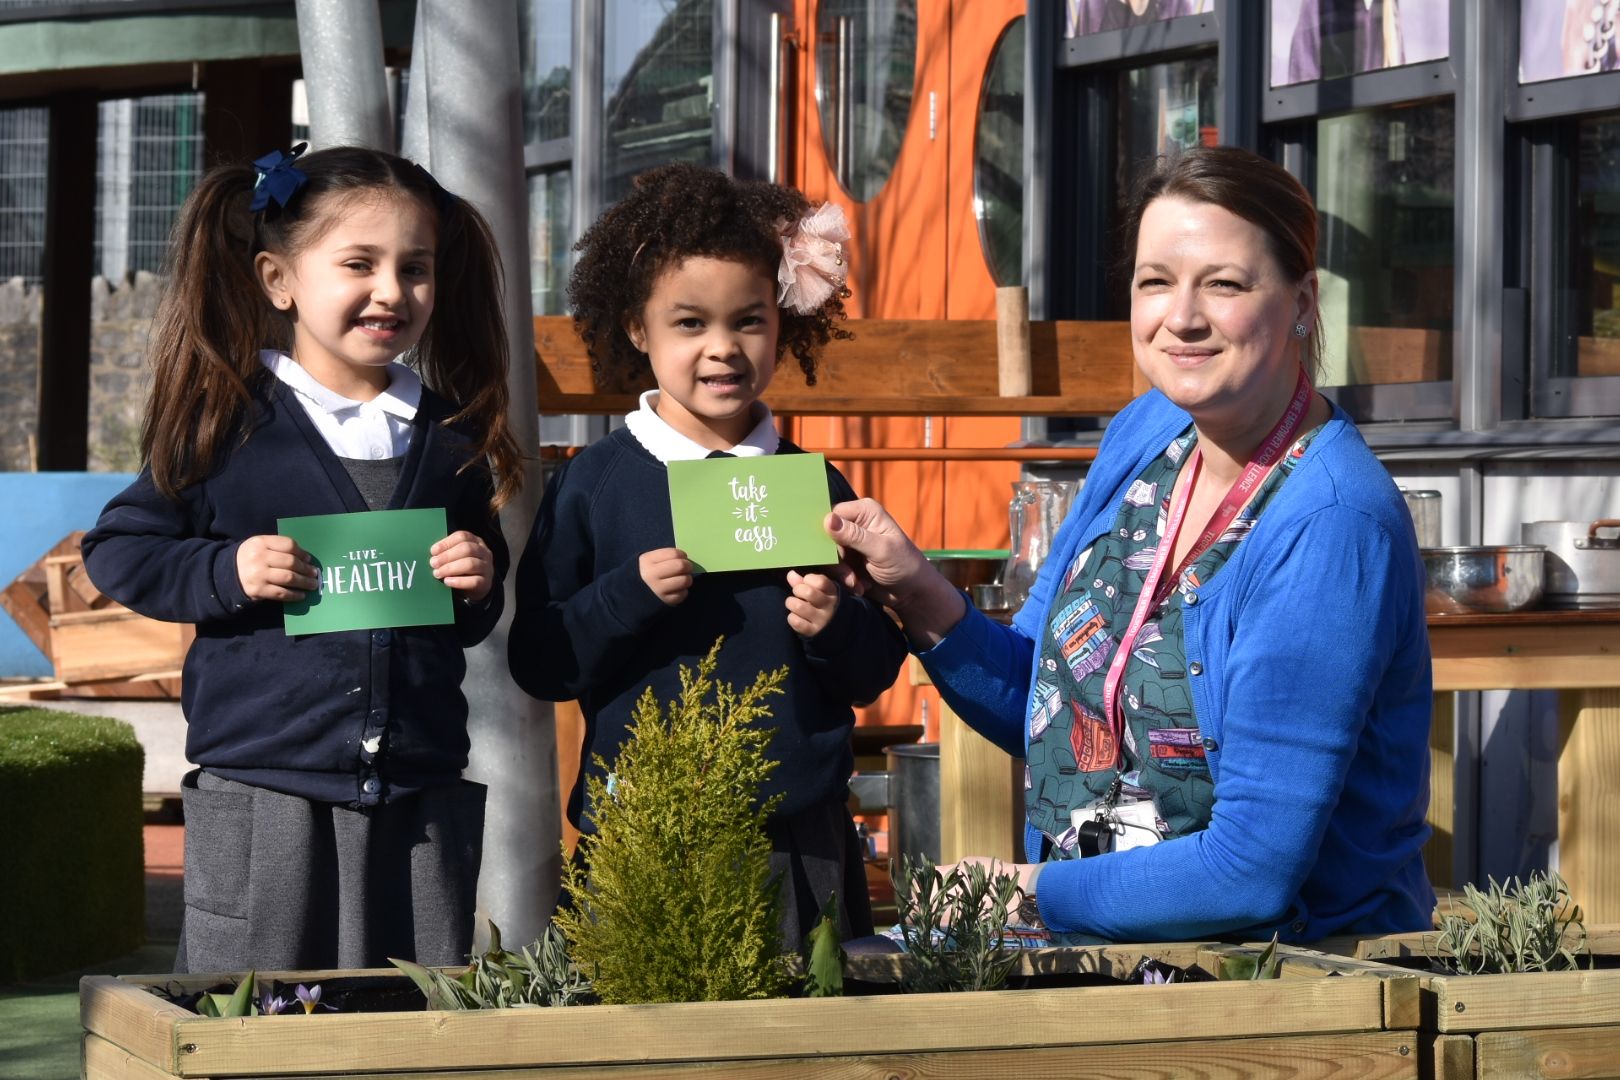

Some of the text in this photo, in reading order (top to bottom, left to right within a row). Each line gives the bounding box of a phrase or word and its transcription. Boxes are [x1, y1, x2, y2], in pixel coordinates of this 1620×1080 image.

[1270, 410, 1298, 449] EMPOWER
[1238, 446, 1276, 493] EXCELLENCE
[727, 474, 768, 502] take
[745, 502, 761, 522] it
[734, 525, 778, 552] easy
[1184, 529, 1215, 566] TOGETHER
[317, 560, 417, 596] HEALTHY
[1147, 544, 1169, 583] EMPOWER
